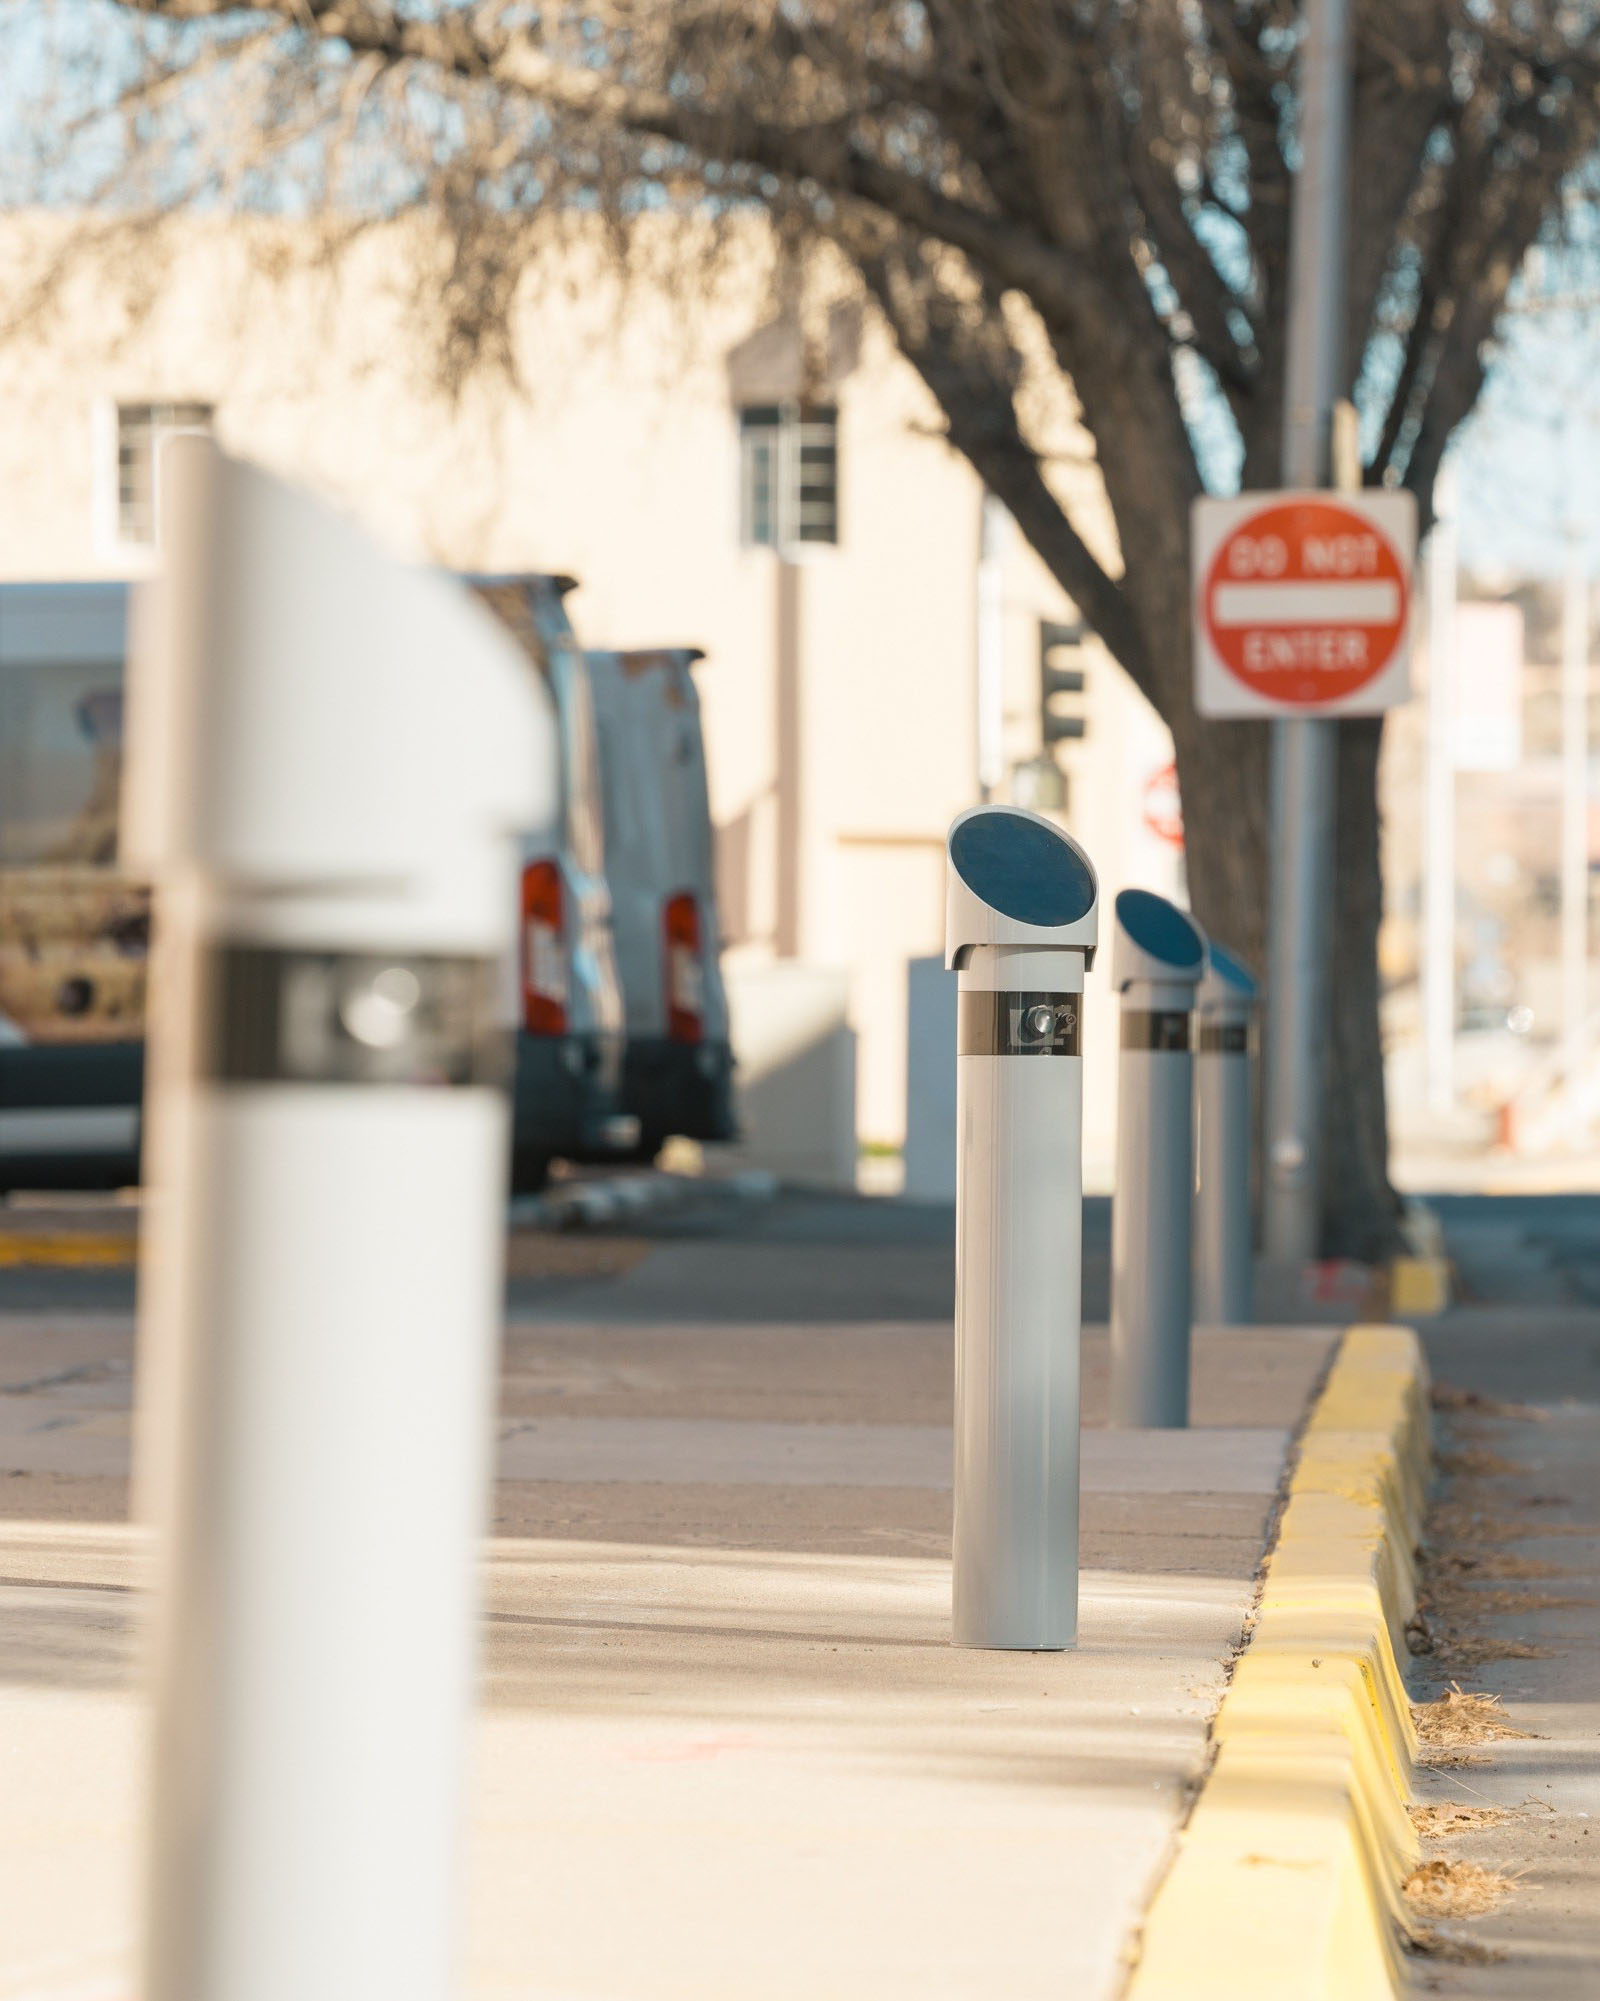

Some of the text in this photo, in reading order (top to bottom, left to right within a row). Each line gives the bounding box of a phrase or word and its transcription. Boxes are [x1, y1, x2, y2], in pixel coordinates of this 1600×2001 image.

[1228, 532, 1378, 577] DO NOT
[1242, 630, 1368, 672] ENTER
